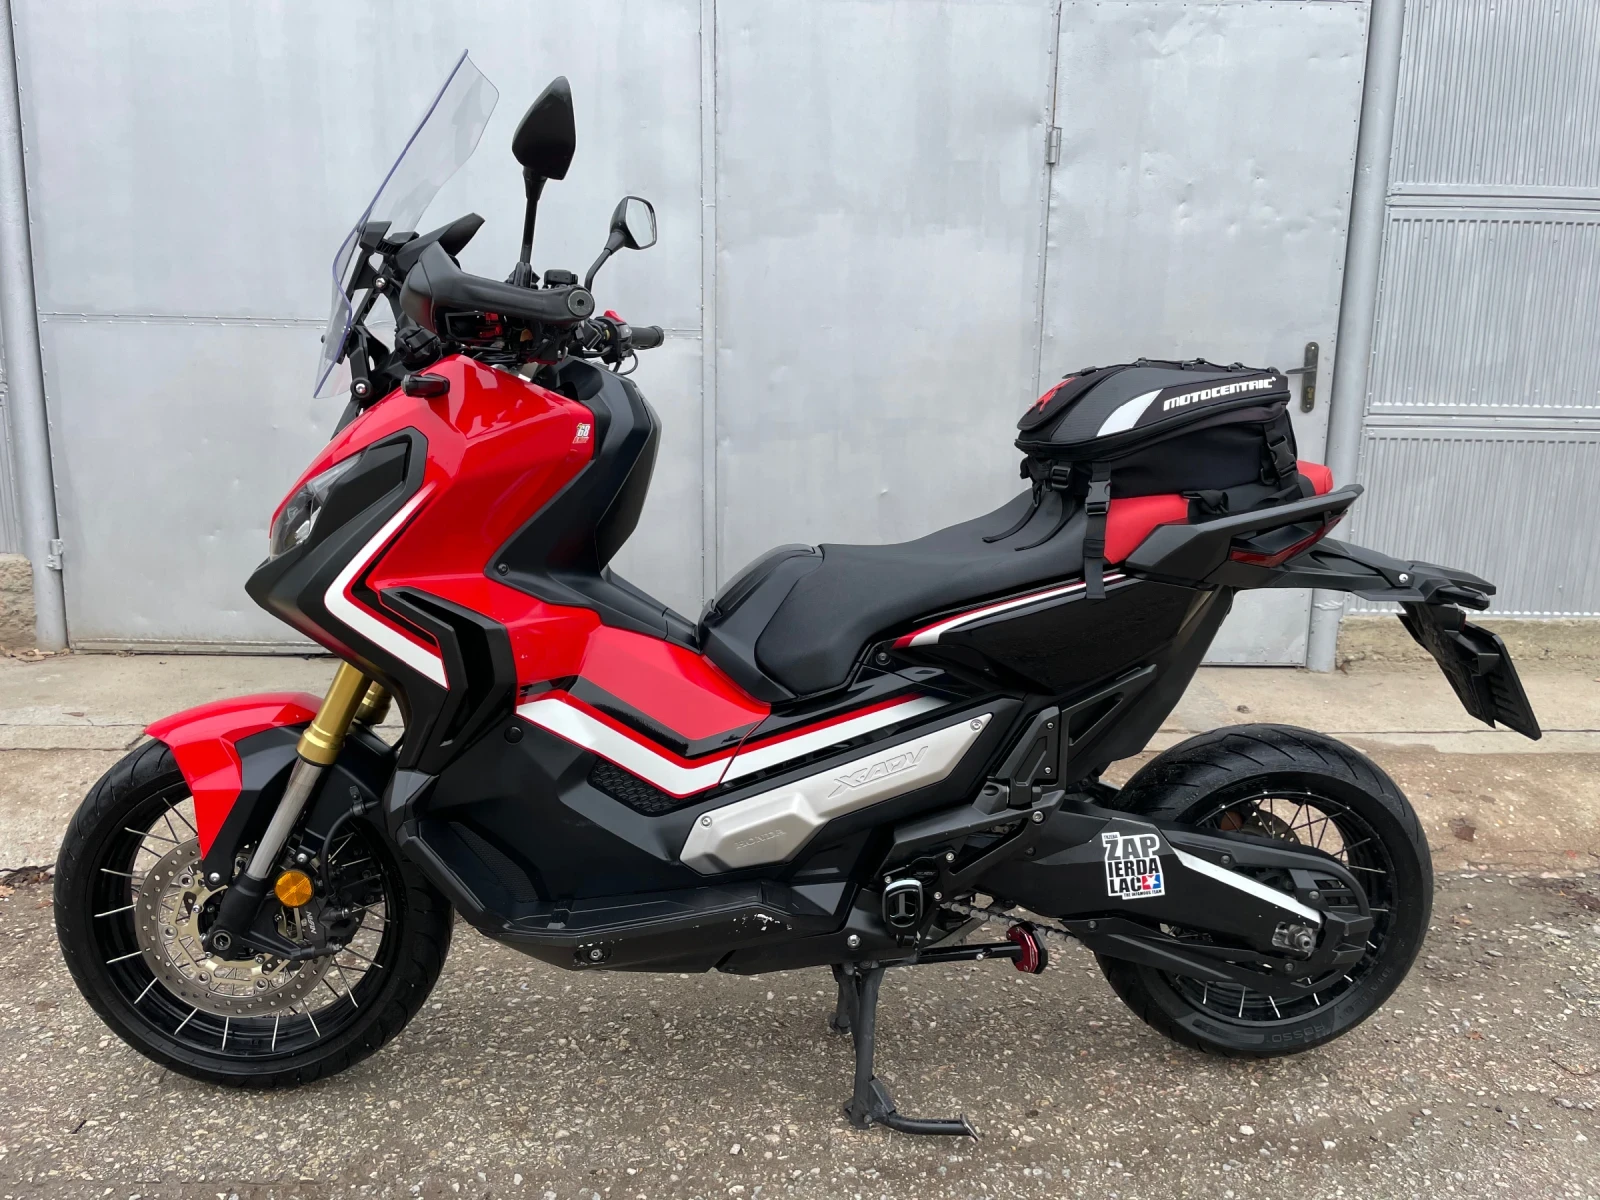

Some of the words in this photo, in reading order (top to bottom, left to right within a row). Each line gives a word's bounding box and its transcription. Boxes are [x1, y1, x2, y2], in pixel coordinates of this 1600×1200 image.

[1163, 378, 1274, 411] MOTOCENTRIC
[734, 829, 787, 850] HONDA
[1104, 836, 1157, 861] ZAP
[1107, 857, 1160, 878] IERDA
[1271, 1020, 1326, 1043] ROSSO
